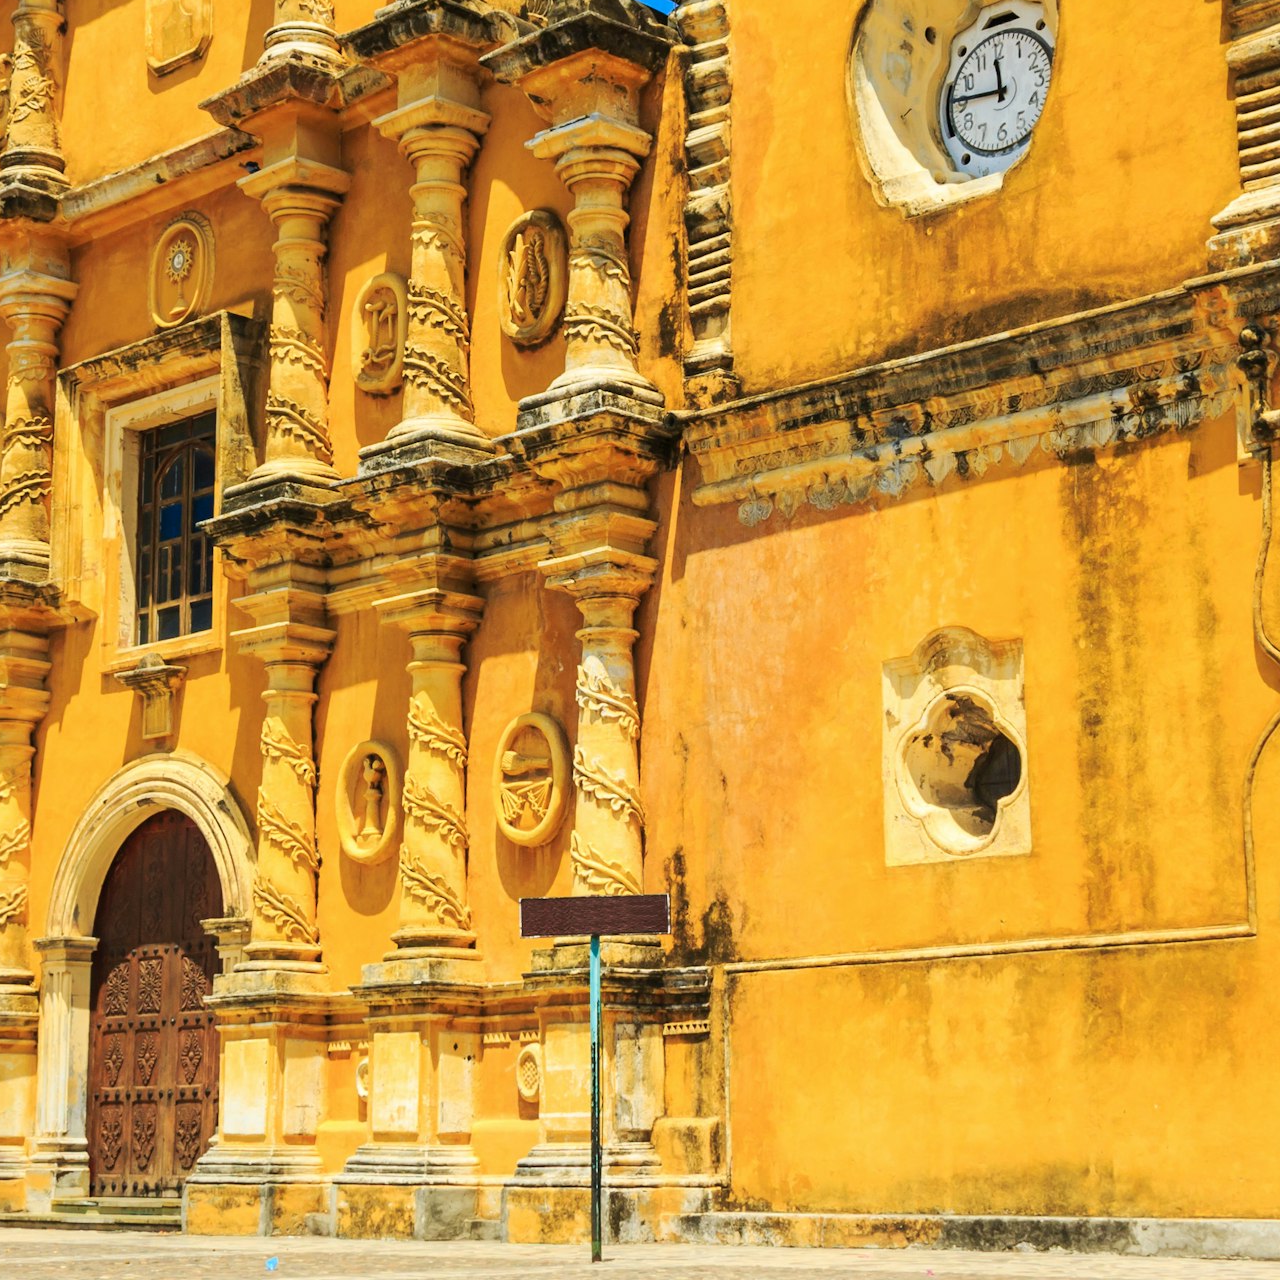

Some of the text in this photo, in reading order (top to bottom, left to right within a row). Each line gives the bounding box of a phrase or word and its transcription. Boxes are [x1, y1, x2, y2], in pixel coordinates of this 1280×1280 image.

[993, 40, 1004, 61] 12
[1015, 40, 1022, 58] 1
[976, 53, 986, 72] 11
[1028, 52, 1038, 71] 2
[963, 73, 974, 92] 10
[1034, 68, 1044, 87] 3
[1028, 89, 1038, 108] 4
[964, 113, 973, 131] 8
[1016, 110, 1025, 130] 5
[978, 122, 987, 142] 7
[997, 122, 1007, 141] 6
